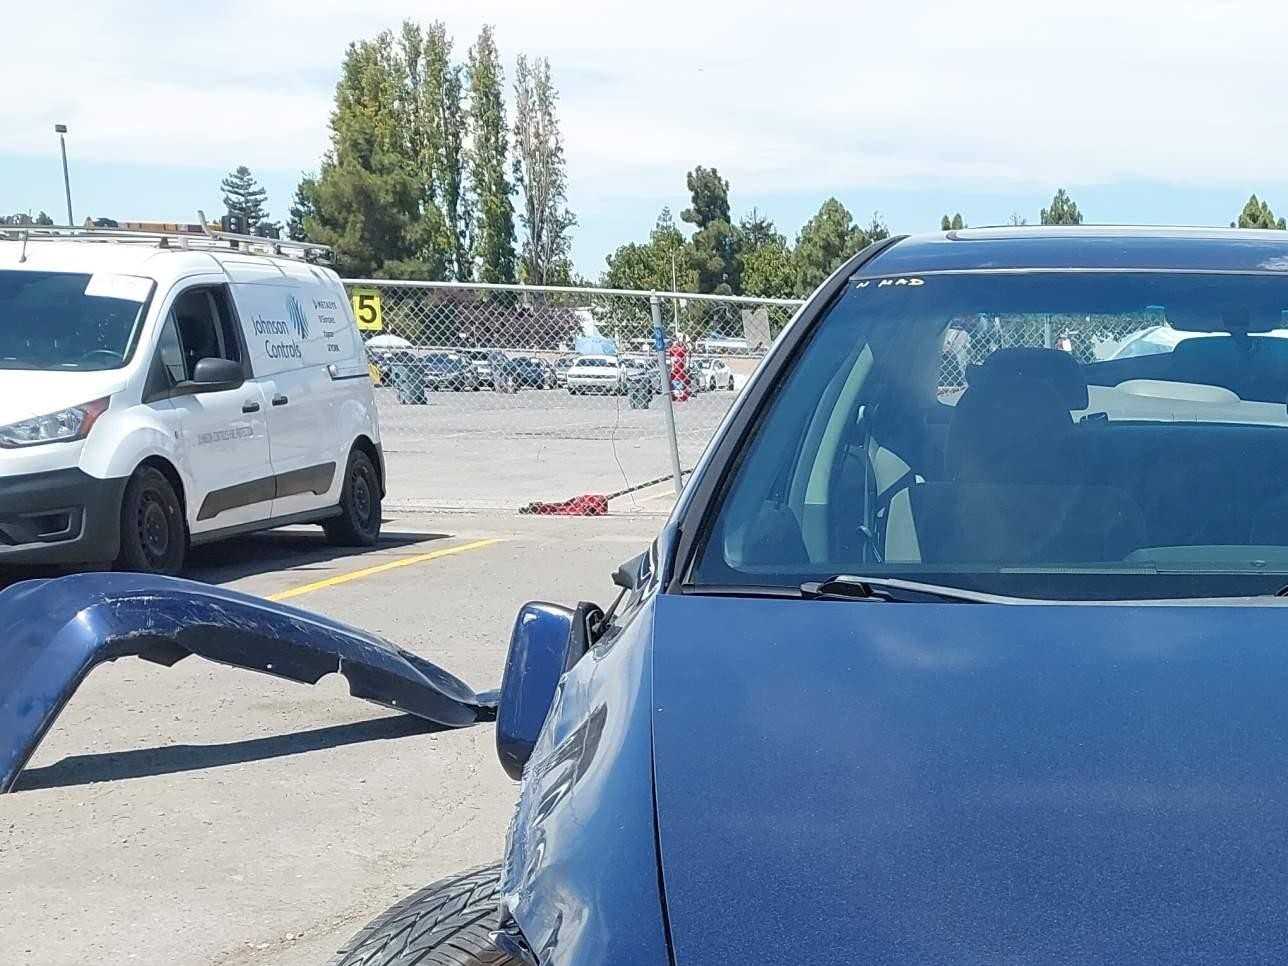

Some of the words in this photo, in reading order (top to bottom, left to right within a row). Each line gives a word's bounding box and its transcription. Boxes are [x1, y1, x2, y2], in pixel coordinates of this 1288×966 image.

[359, 295, 377, 324] 5
[251, 313, 289, 336] Johnson
[265, 340, 302, 359] Controls
